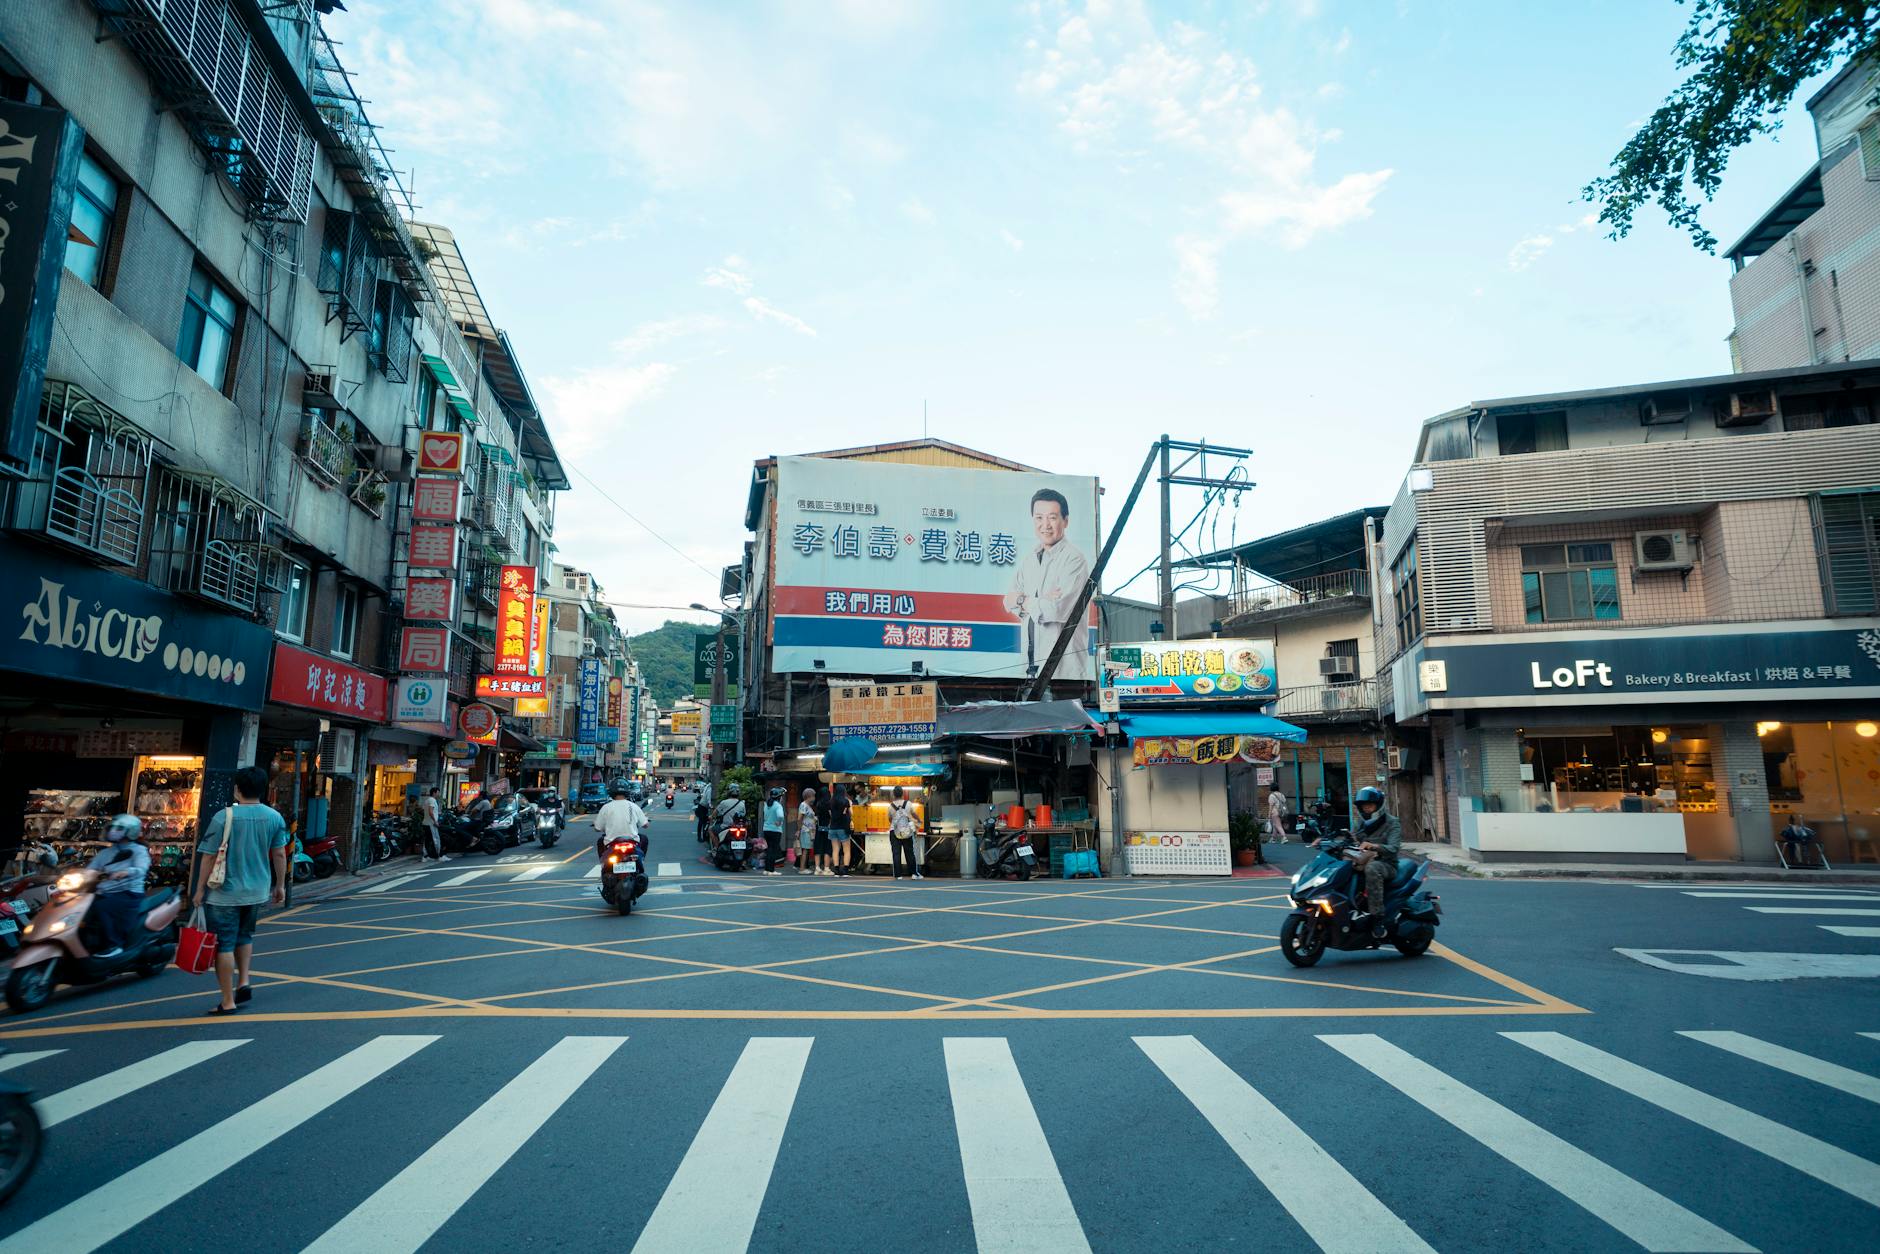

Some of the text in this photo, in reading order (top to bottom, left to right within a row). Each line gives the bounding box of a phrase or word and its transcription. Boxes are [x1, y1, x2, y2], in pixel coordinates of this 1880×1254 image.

[921, 507, 954, 518] 立法委員
[793, 521, 1016, 563] 李伯壽 費鴻泰
[404, 482, 456, 669] 福華藥局
[826, 590, 916, 615] 我們用心
[883, 624, 973, 648] 為您服務
[1531, 659, 1613, 688] LoFt
[1626, 671, 1752, 687] Bakery & Breakfast
[1765, 667, 1799, 681] 烘焙
[1817, 665, 1852, 680] 早餐
[306, 663, 366, 711] 邱記涼麵
